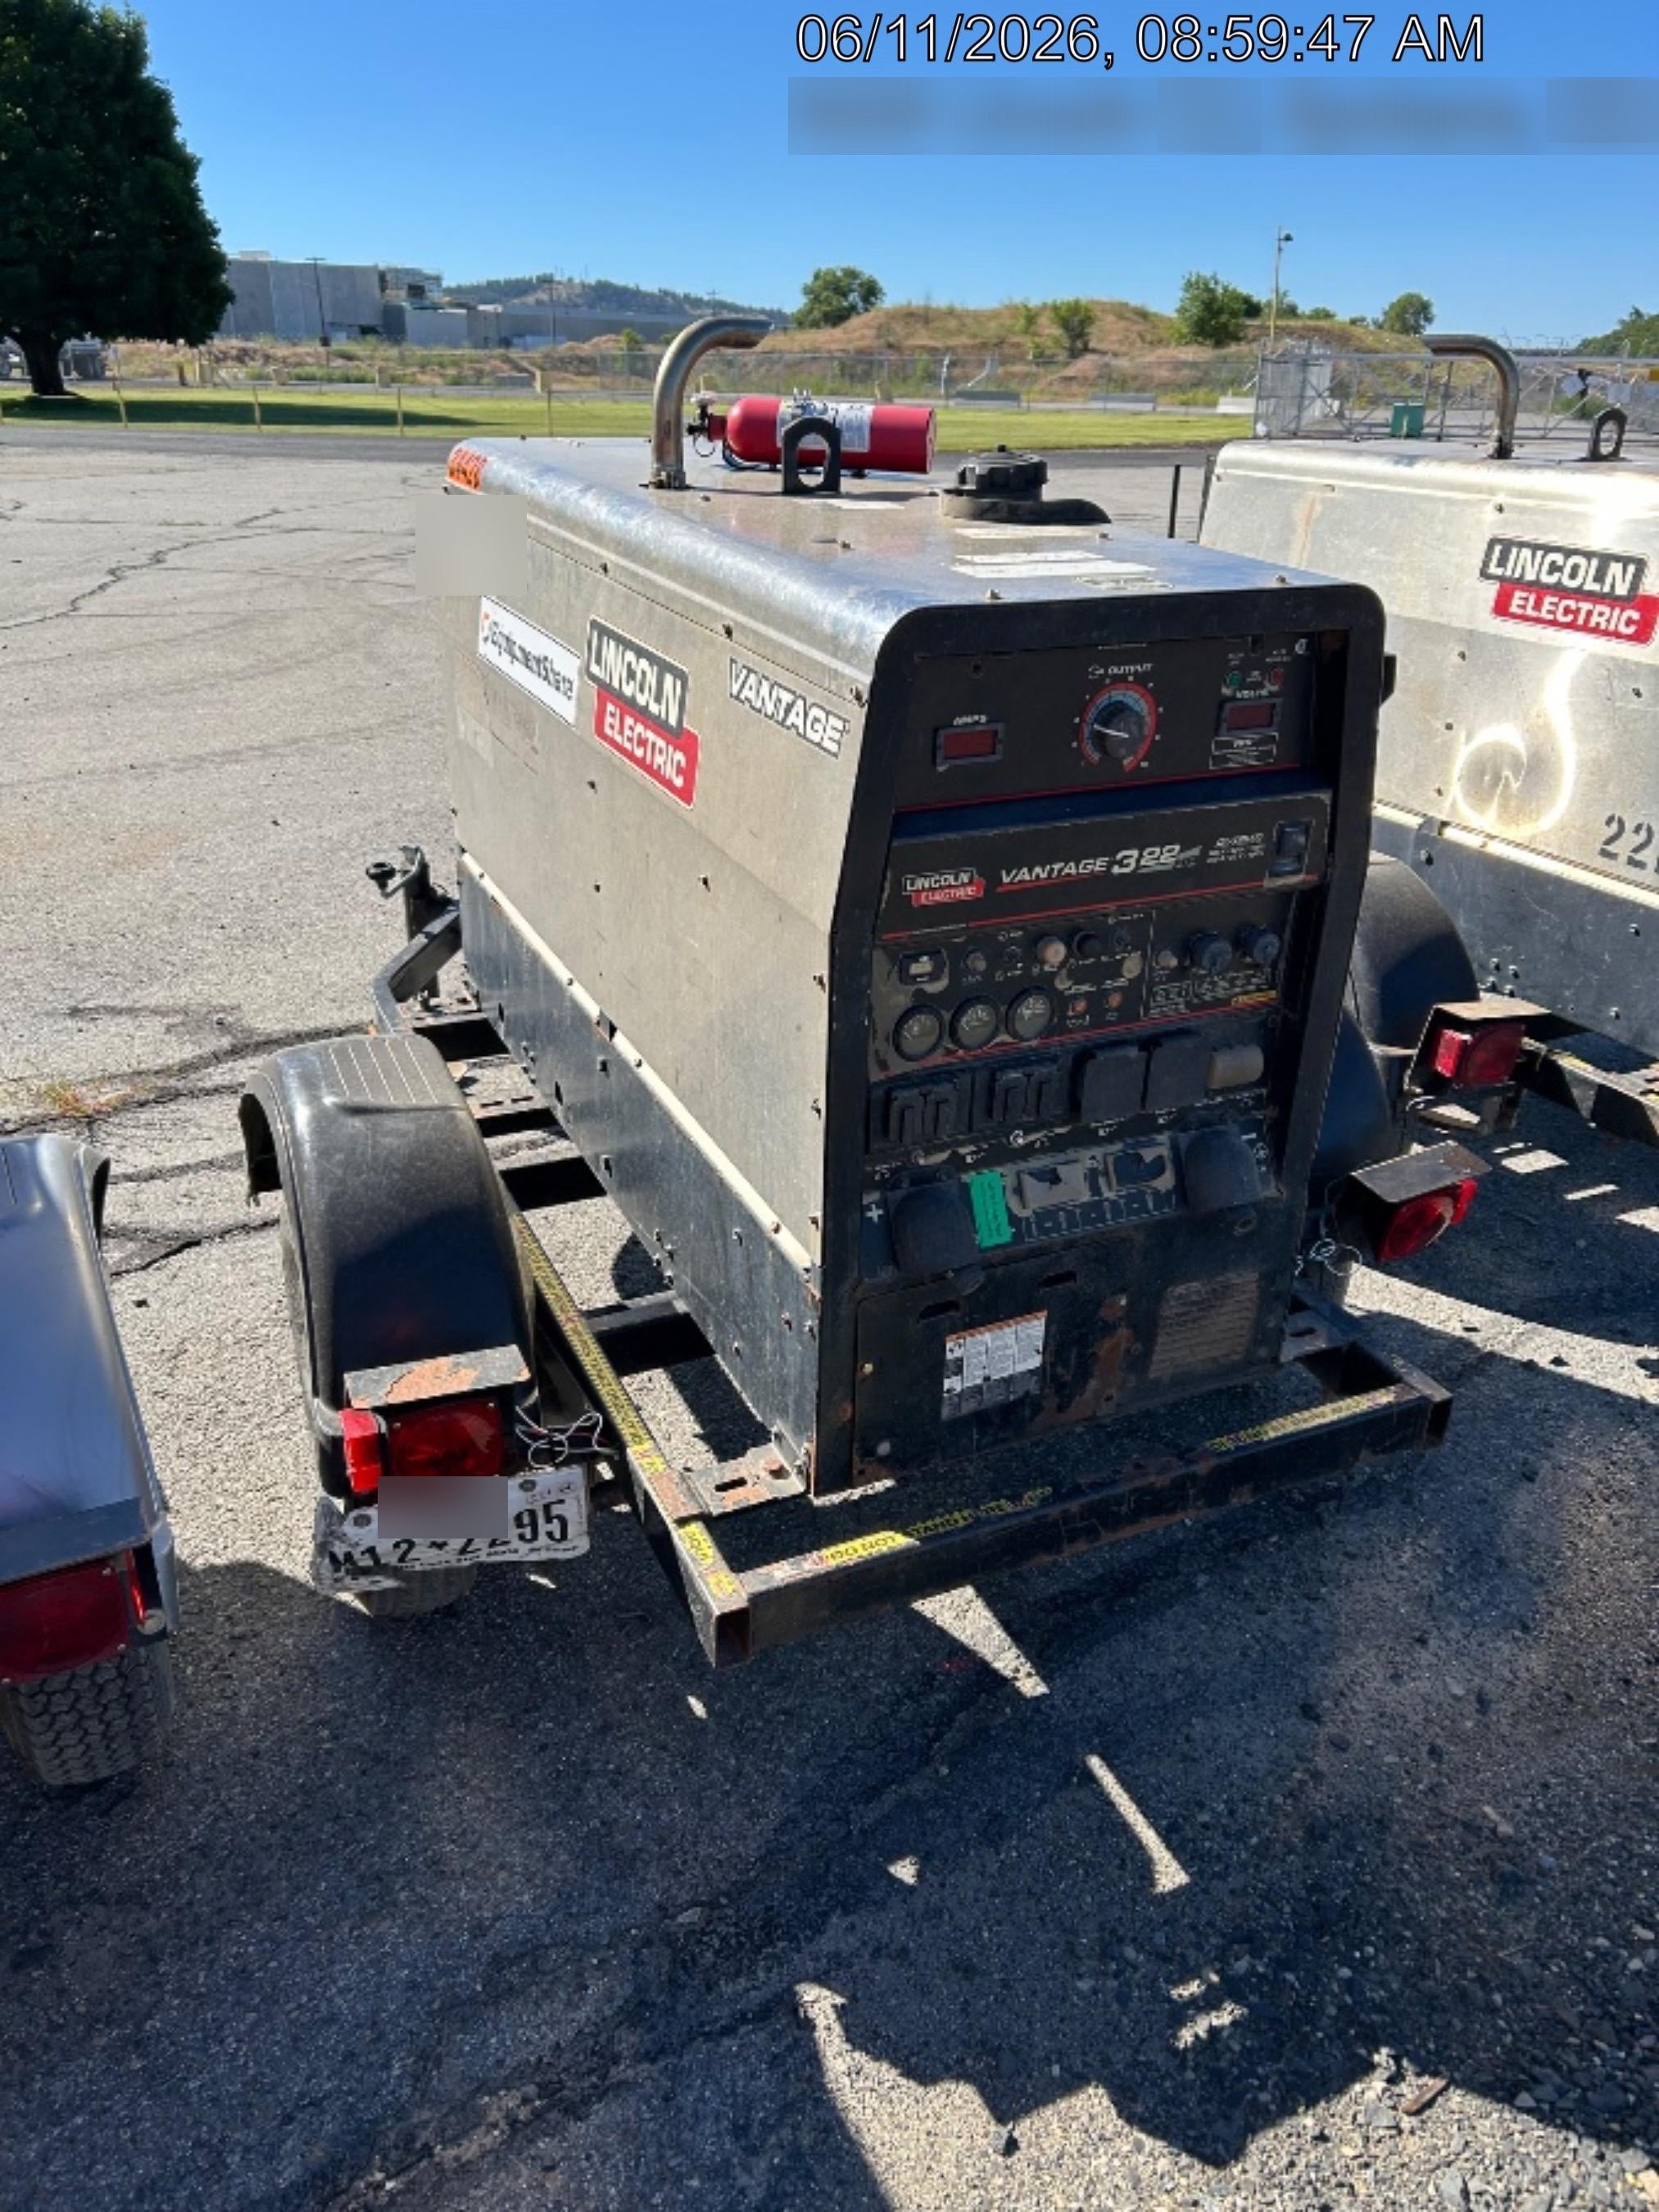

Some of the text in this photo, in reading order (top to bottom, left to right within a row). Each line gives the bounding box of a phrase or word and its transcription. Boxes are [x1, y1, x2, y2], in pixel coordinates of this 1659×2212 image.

[1488, 545, 1635, 596] LINCOLN
[1509, 590, 1640, 635] ELECTRIC
[589, 629, 683, 730] LINCOLN
[1108, 664, 1153, 674] OUTPUT
[731, 660, 847, 755] VANTAGE
[604, 702, 687, 790] ELECTRIC
[1598, 813, 1659, 873] 22
[905, 871, 972, 891] LINCOLN
[921, 886, 977, 900] ELECTRIC
[1000, 858, 1109, 884] VANTAGE
